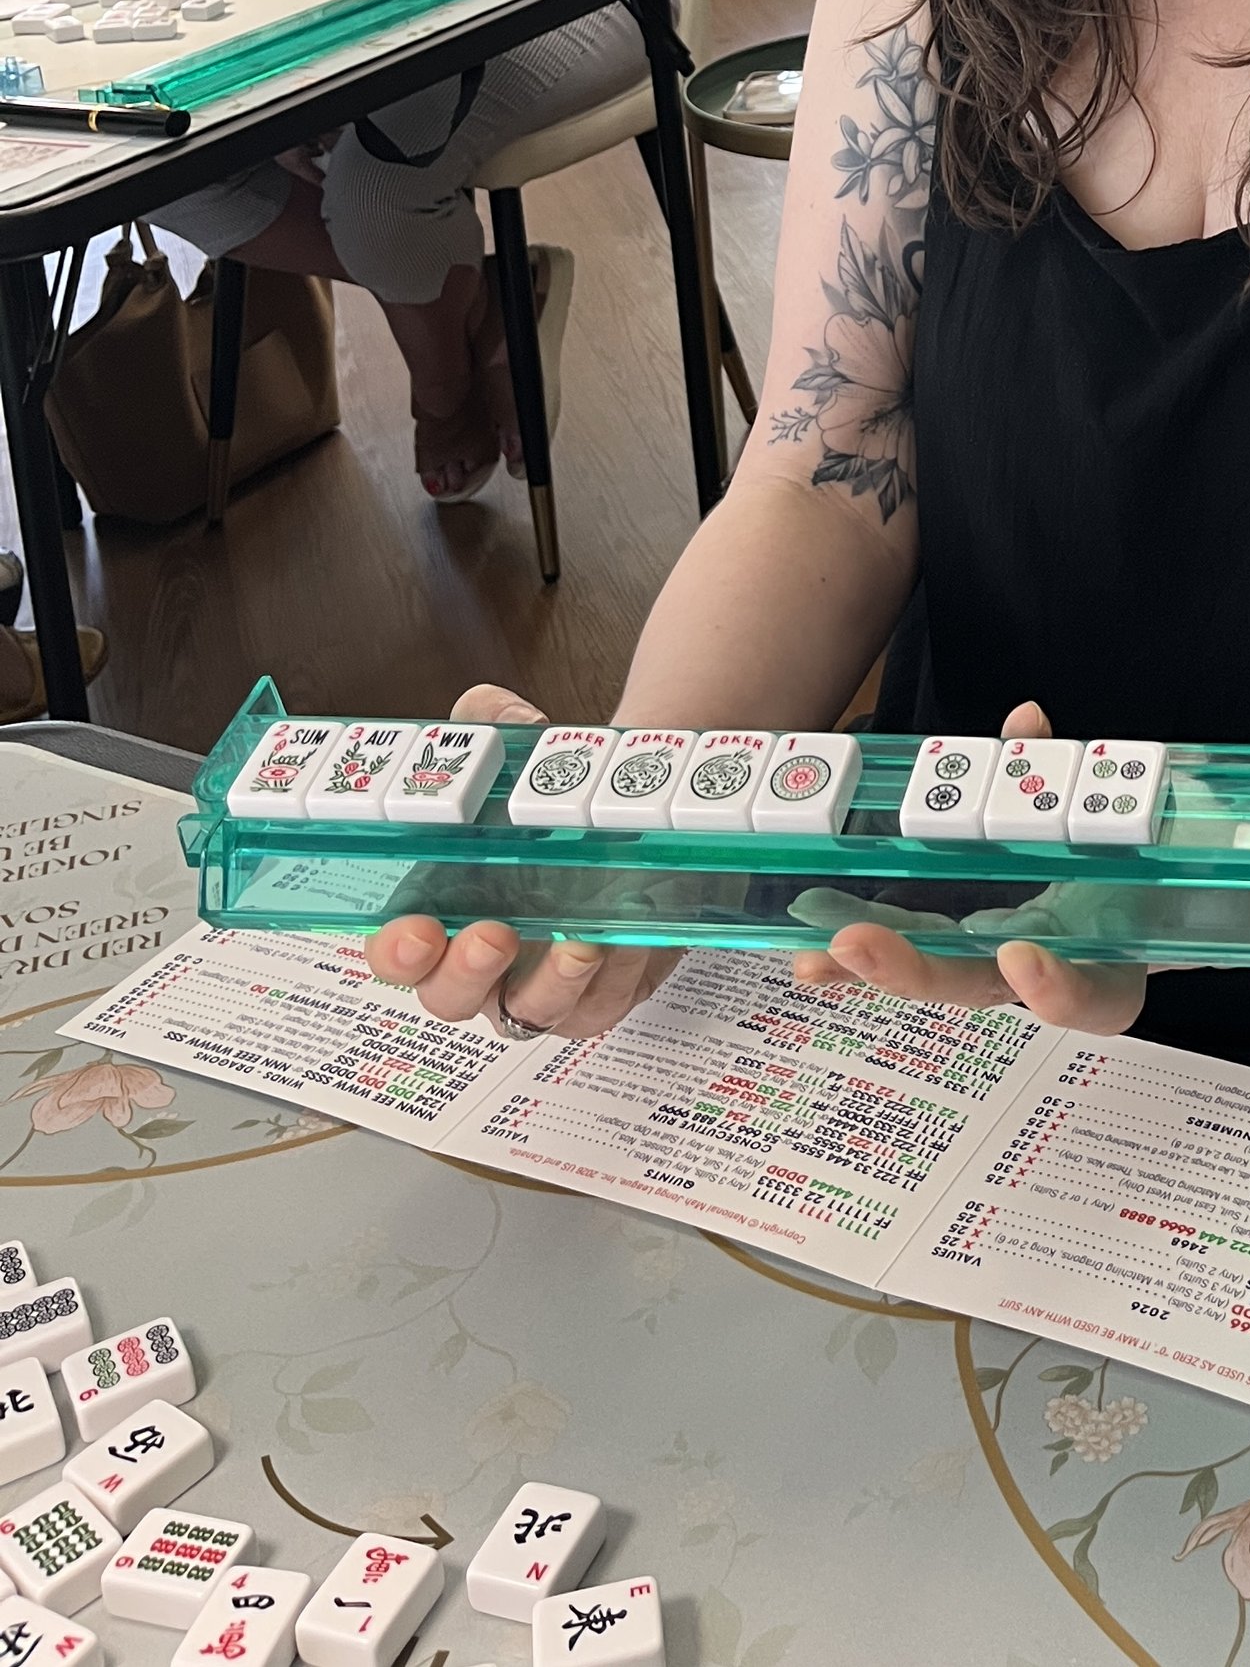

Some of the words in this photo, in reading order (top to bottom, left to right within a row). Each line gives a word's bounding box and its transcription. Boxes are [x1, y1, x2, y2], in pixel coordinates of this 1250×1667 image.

[273, 724, 290, 737] 2
[289, 729, 330, 746] SUM
[349, 726, 365, 740] 3
[364, 730, 402, 746] AUT
[426, 726, 441, 739] 4
[438, 732, 475, 748] WIN
[546, 731, 605, 747] JOKER
[626, 732, 686, 748] JOKER
[704, 734, 765, 750] JOKER
[786, 737, 796, 752] 1
[928, 740, 943, 754] 2
[1011, 742, 1025, 755] 3
[1092, 743, 1107, 756] 4
[0, 800, 142, 839] SINGLE
[24, 834, 71, 857] BE
[34, 906, 170, 948] GREEN
[83, 931, 162, 961] RED
[361, 1001, 382, 1012] SS
[379, 1007, 421, 1025] WWW
[82, 1020, 127, 1039] VALUES
[422, 1019, 460, 1036] 2026
[458, 1030, 485, 1045] EEE
[762, 1035, 802, 1053] 13579
[183, 1036, 234, 1056] WWWW
[484, 1039, 510, 1053] NN
[192, 1050, 255, 1074] DRAGONS
[231, 1048, 263, 1064] EEEE
[258, 1056, 292, 1072] NNN
[261, 1070, 305, 1090] WINDS
[298, 1067, 336, 1086] SSSS
[330, 1078, 372, 1099] WWW
[370, 1091, 397, 1107] EEE
[393, 1099, 439, 1122] NNNN
[498, 1103, 521, 1115] 45
[647, 1110, 678, 1126] RUN
[480, 1124, 529, 1144] VALUES
[677, 1119, 772, 1153] CONSECUTIVE
[642, 1168, 695, 1190] QUINTS
[756, 1174, 803, 1197] 33333
[803, 1189, 826, 1204] 22
[826, 1198, 871, 1222] 11111
[872, 1216, 892, 1229] FF
[947, 1222, 969, 1235] 25
[938, 1233, 961, 1247] 25
[969, 1227, 983, 1238] X
[961, 1239, 975, 1250] X
[1029, 1241, 1057, 1258] Kong
[1170, 1236, 1209, 1255] 2468
[930, 1245, 982, 1267] VALUES
[1104, 1262, 1153, 1285] Matching
[1165, 1282, 1193, 1297] Suits
[1193, 1290, 1203, 1301] 2
[1167, 1296, 1195, 1312] Suits)
[1203, 1292, 1230, 1309] (Any
[1024, 1305, 1044, 1317] ANY
[1130, 1300, 1171, 1321] 2026
[1193, 1305, 1203, 1315] 2
[1202, 1306, 1226, 1322] (Any
[1044, 1311, 1071, 1326] WITH
[1072, 1319, 1100, 1334] USED
[1101, 1327, 1115, 1339] BE
[1114, 1333, 1138, 1347] MAY
[1138, 1339, 1152, 1351] IT
[1171, 1350, 1200, 1366] ZERO
[1199, 1359, 1216, 1371] AS
[1216, 1365, 1245, 1381] USED
[98, 1473, 124, 1493] W
[513, 1508, 572, 1544] 北
[526, 1562, 549, 1581] N
[231, 1573, 249, 1590] 4
[630, 1584, 651, 1598] E
[562, 1603, 628, 1652] 東
